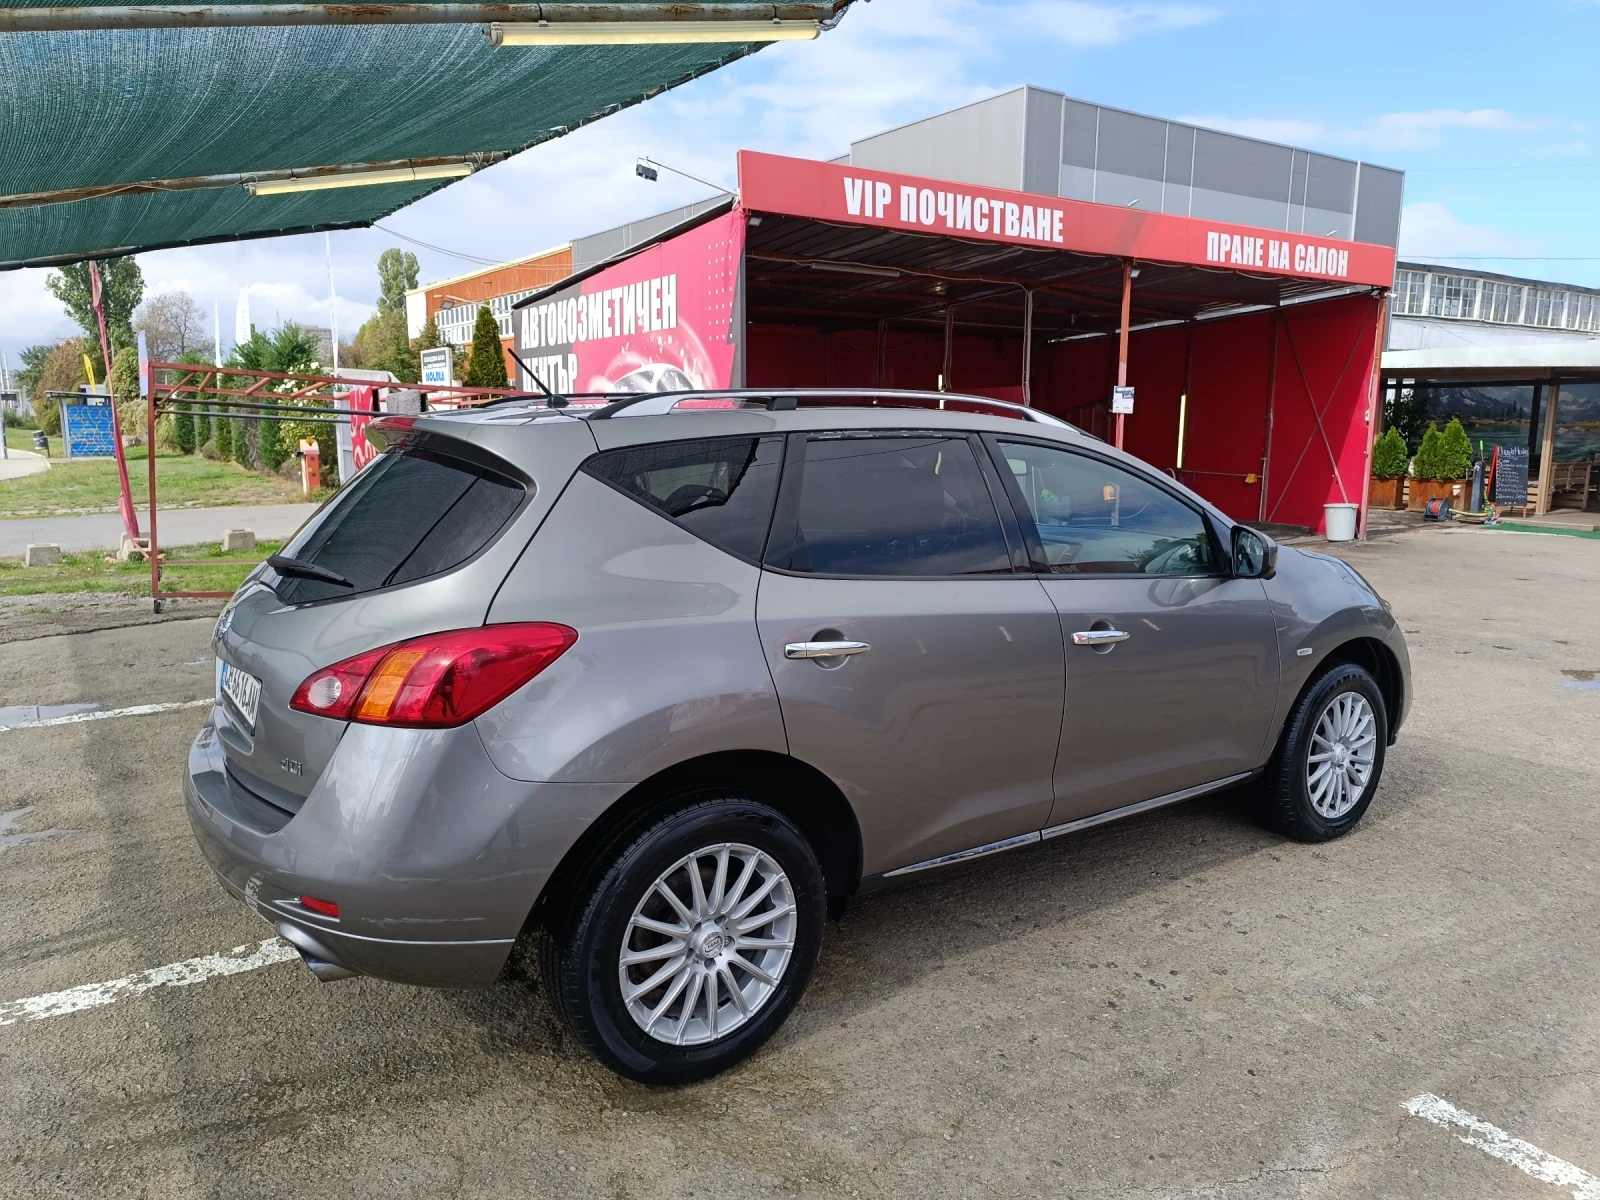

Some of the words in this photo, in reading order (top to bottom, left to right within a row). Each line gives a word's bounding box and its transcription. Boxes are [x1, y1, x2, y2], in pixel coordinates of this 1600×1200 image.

[843, 177, 892, 219] VIP
[900, 185, 1064, 243] ПОЧИСТВАНЕ
[1207, 231, 1264, 267] ПРАНЕ
[1268, 239, 1290, 271] НА
[1294, 243, 1349, 277] САЛОН
[521, 273, 678, 350] АВТОКОЗМЕТИЧЕН
